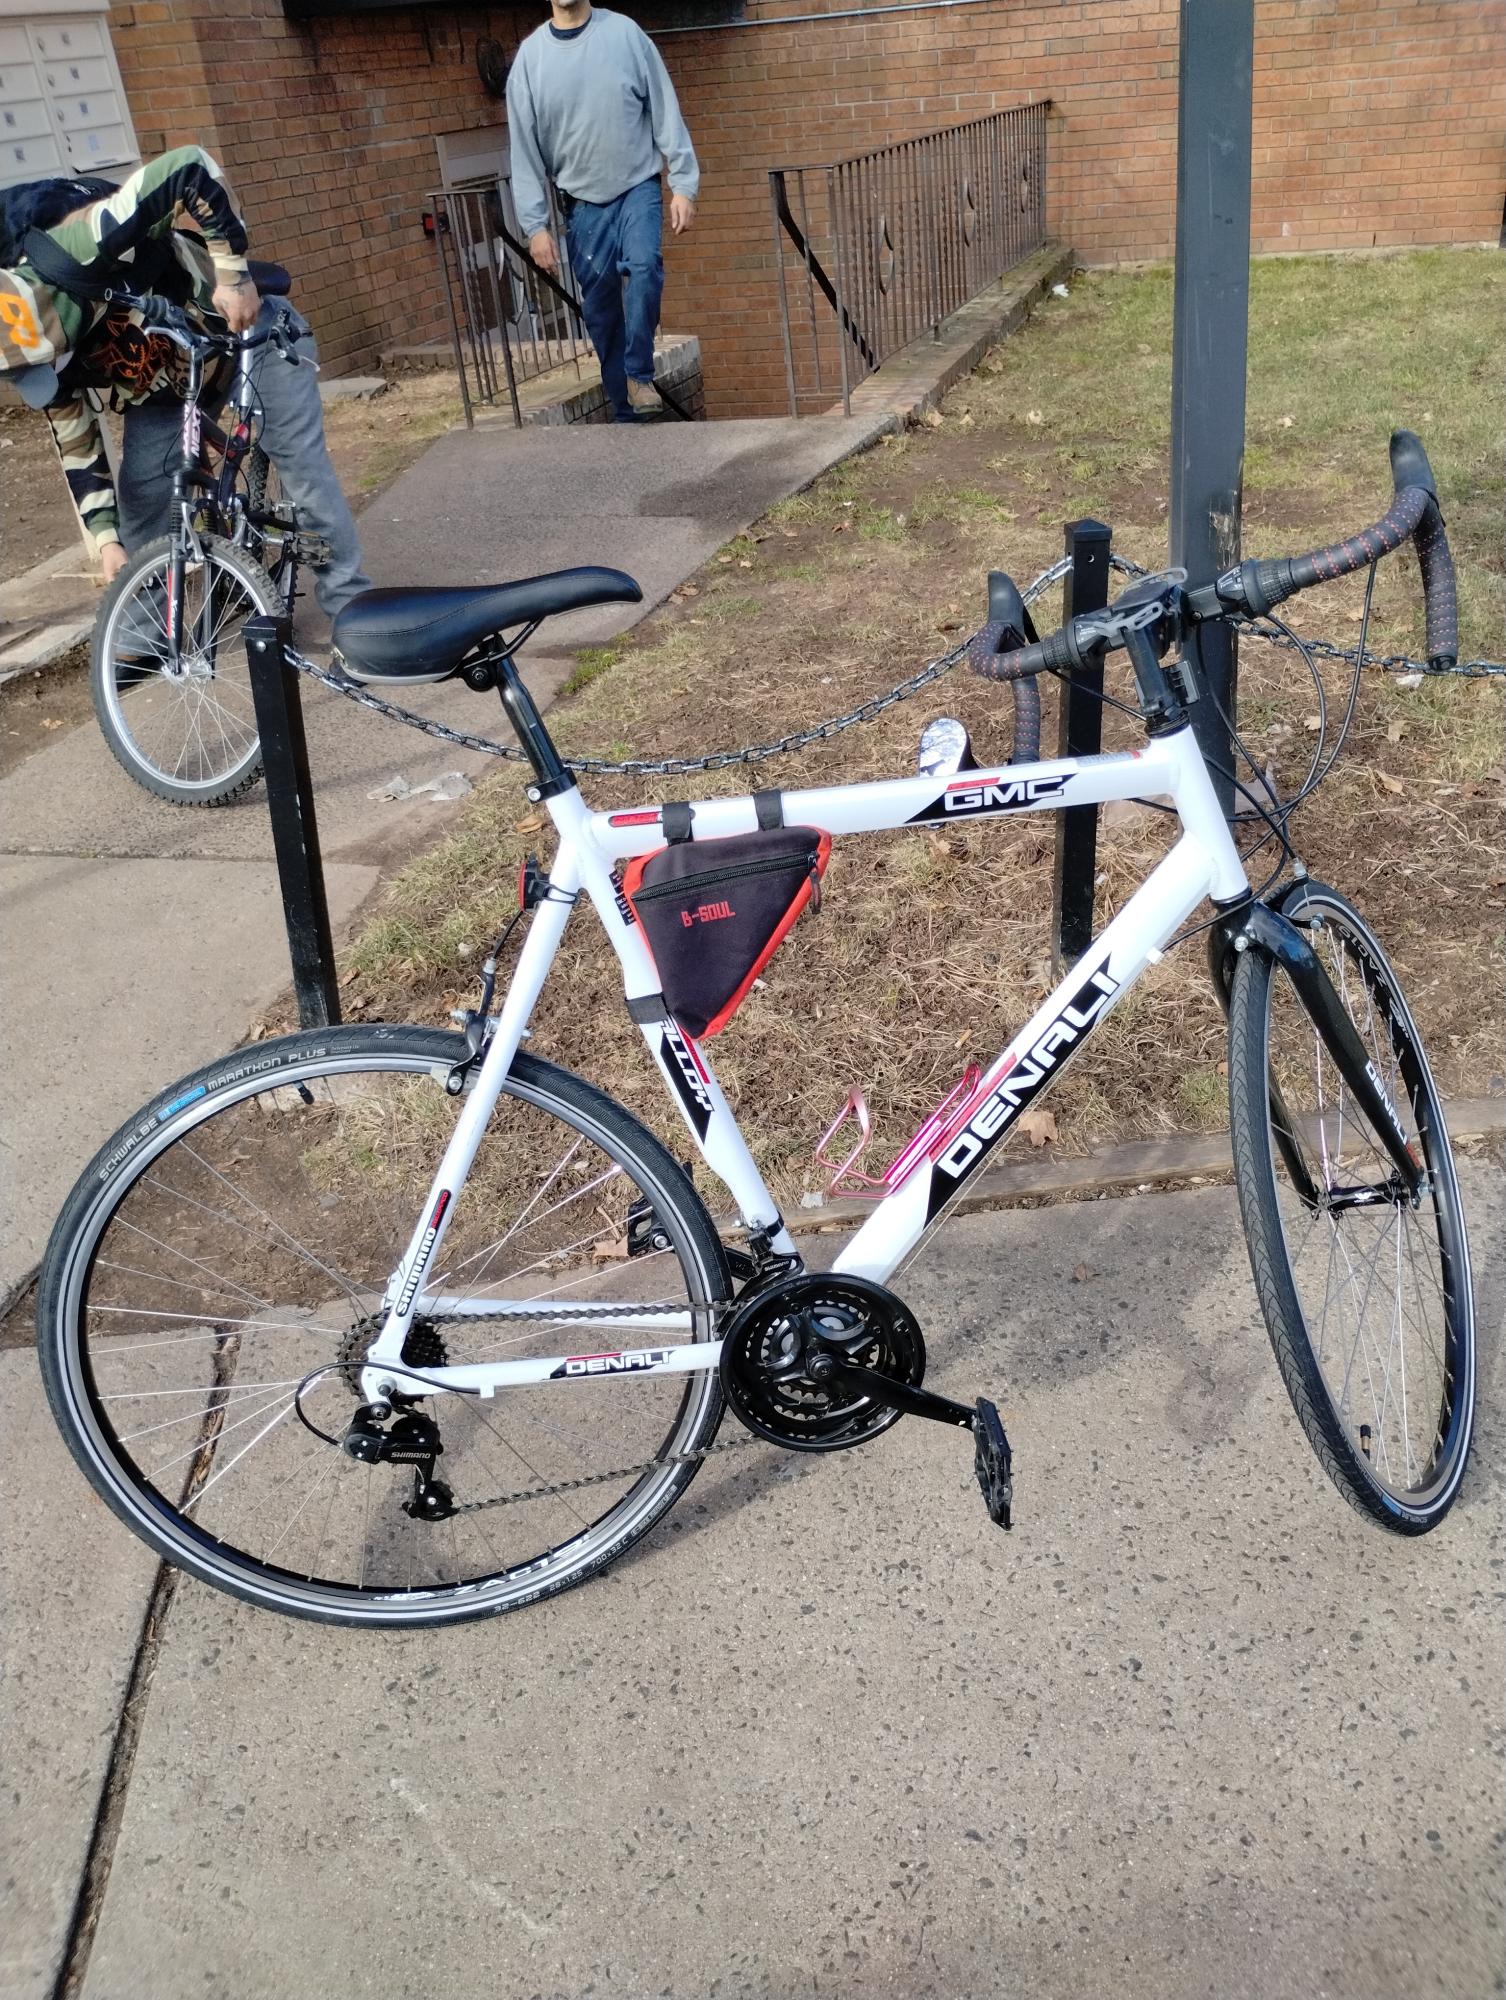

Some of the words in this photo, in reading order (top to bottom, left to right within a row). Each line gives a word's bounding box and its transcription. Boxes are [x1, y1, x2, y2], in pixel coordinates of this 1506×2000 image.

[945, 776, 1064, 811] GMC
[681, 900, 736, 928] B-SOUL
[937, 971, 1120, 1179] DENALI
[100, 1118, 159, 1181] SCHWALBE
[207, 1056, 282, 1091] MARATHON
[288, 1047, 327, 1063] PLUS
[1365, 1060, 1408, 1146] DENALI
[396, 1227, 436, 1315] SHIMANO
[566, 1351, 670, 1376] DENALI
[390, 1451, 431, 1459] SHIMANO
[493, 1590, 541, 1613] 32-622
